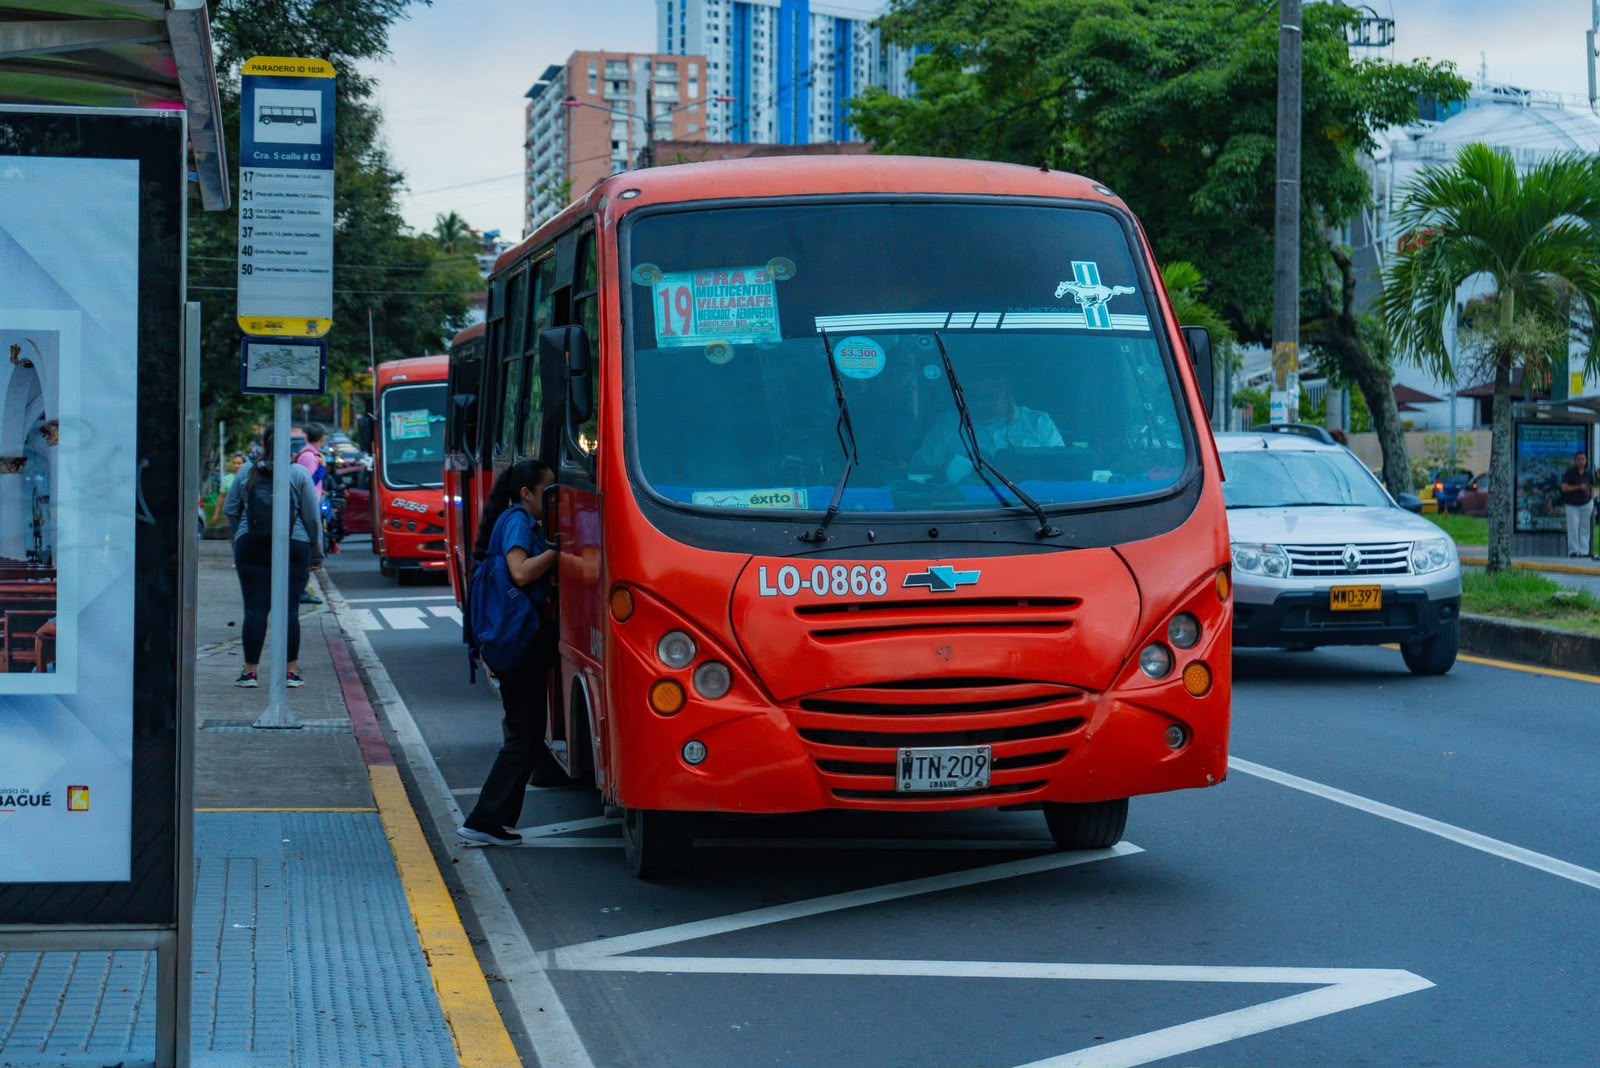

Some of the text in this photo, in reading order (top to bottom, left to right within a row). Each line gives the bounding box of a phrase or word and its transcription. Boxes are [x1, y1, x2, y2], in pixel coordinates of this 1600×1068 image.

[251, 64, 296, 73] PARADERO
[308, 66, 326, 74] 1038
[253, 151, 272, 160] Cra.
[273, 152, 279, 160] 5
[280, 152, 302, 161] calle
[310, 153, 321, 161] 63
[243, 171, 255, 182] 17
[242, 189, 253, 201] 21
[242, 208, 253, 219] 23
[242, 226, 254, 238] 37
[241, 245, 253, 257] 40
[241, 263, 253, 275] 50
[696, 271, 771, 286] CRA 5
[695, 284, 772, 298] MULTICENTRO
[697, 296, 772, 310] VILLACAFE
[659, 286, 693, 336] 19
[750, 493, 791, 506] éxito
[758, 565, 889, 597] LO-0868
